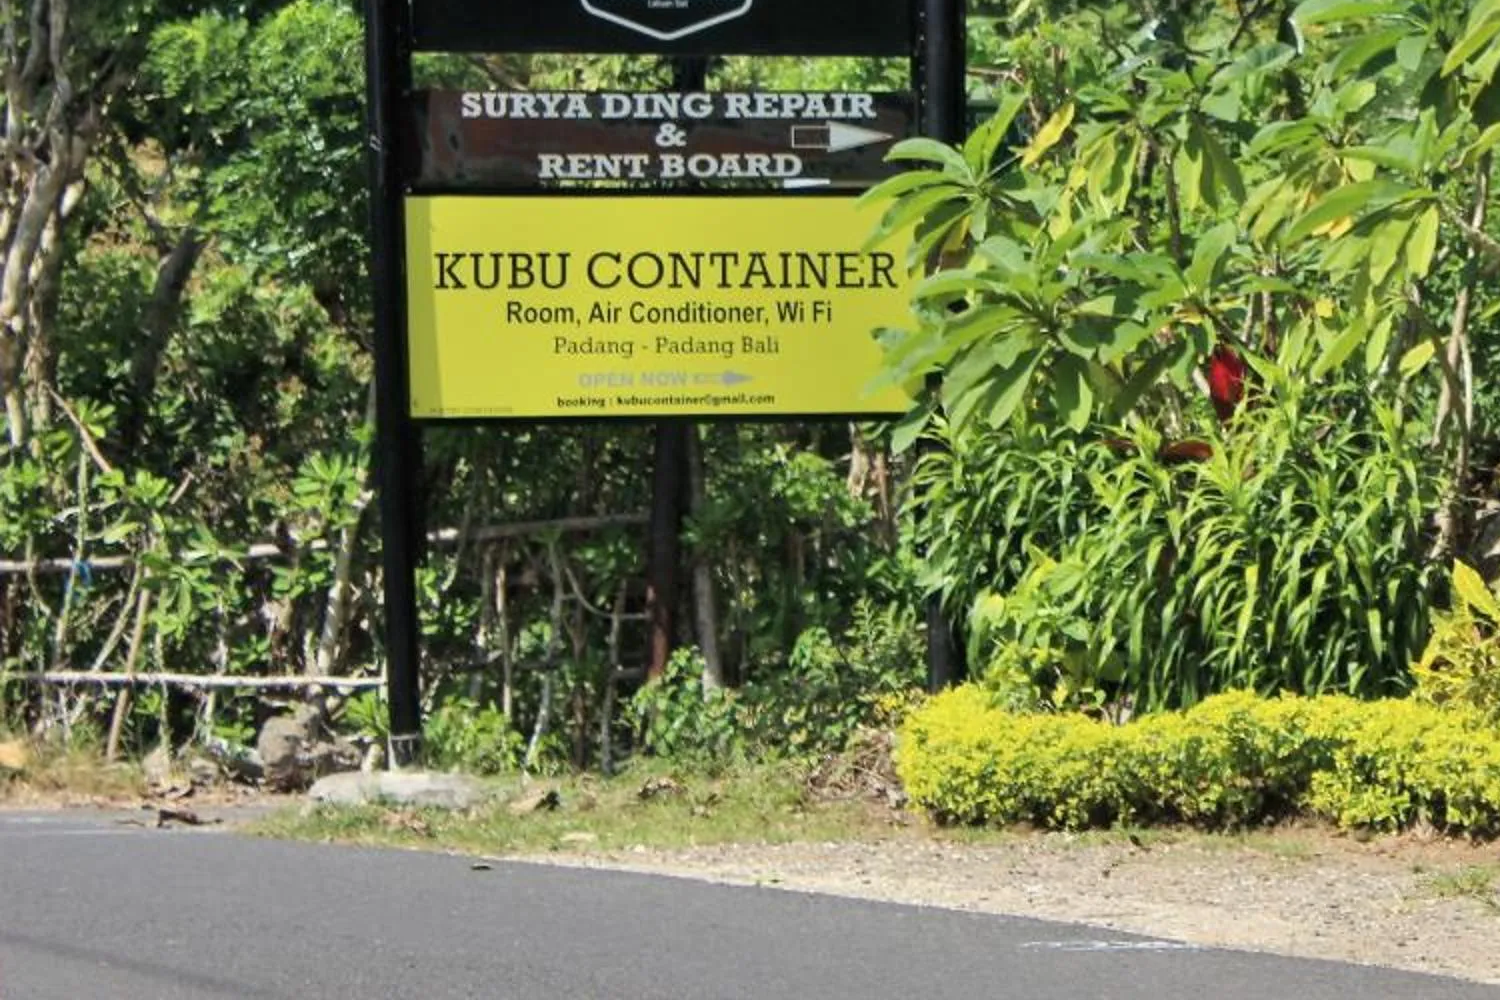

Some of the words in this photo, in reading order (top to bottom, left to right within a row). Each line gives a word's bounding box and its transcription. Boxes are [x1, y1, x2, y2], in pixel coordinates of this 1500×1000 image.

[461, 93, 592, 120] SURYA
[601, 93, 713, 120] DING
[724, 93, 876, 120] REPAIR
[655, 124, 686, 147] &
[538, 154, 650, 179] RENT
[660, 154, 802, 178] BOARD
[434, 251, 570, 290] KUBU
[586, 251, 899, 290] CONTAINER
[506, 301, 581, 325] Room,
[588, 301, 622, 324] Air
[629, 301, 769, 325] Conditioner,
[776, 301, 804, 323] Wi
[812, 301, 832, 322] Fi
[553, 336, 634, 357] Padang
[655, 336, 734, 357] Padang
[741, 335, 779, 354] Bali
[578, 373, 633, 388] OPEN
[641, 371, 688, 386] NOW
[556, 396, 606, 408] booking
